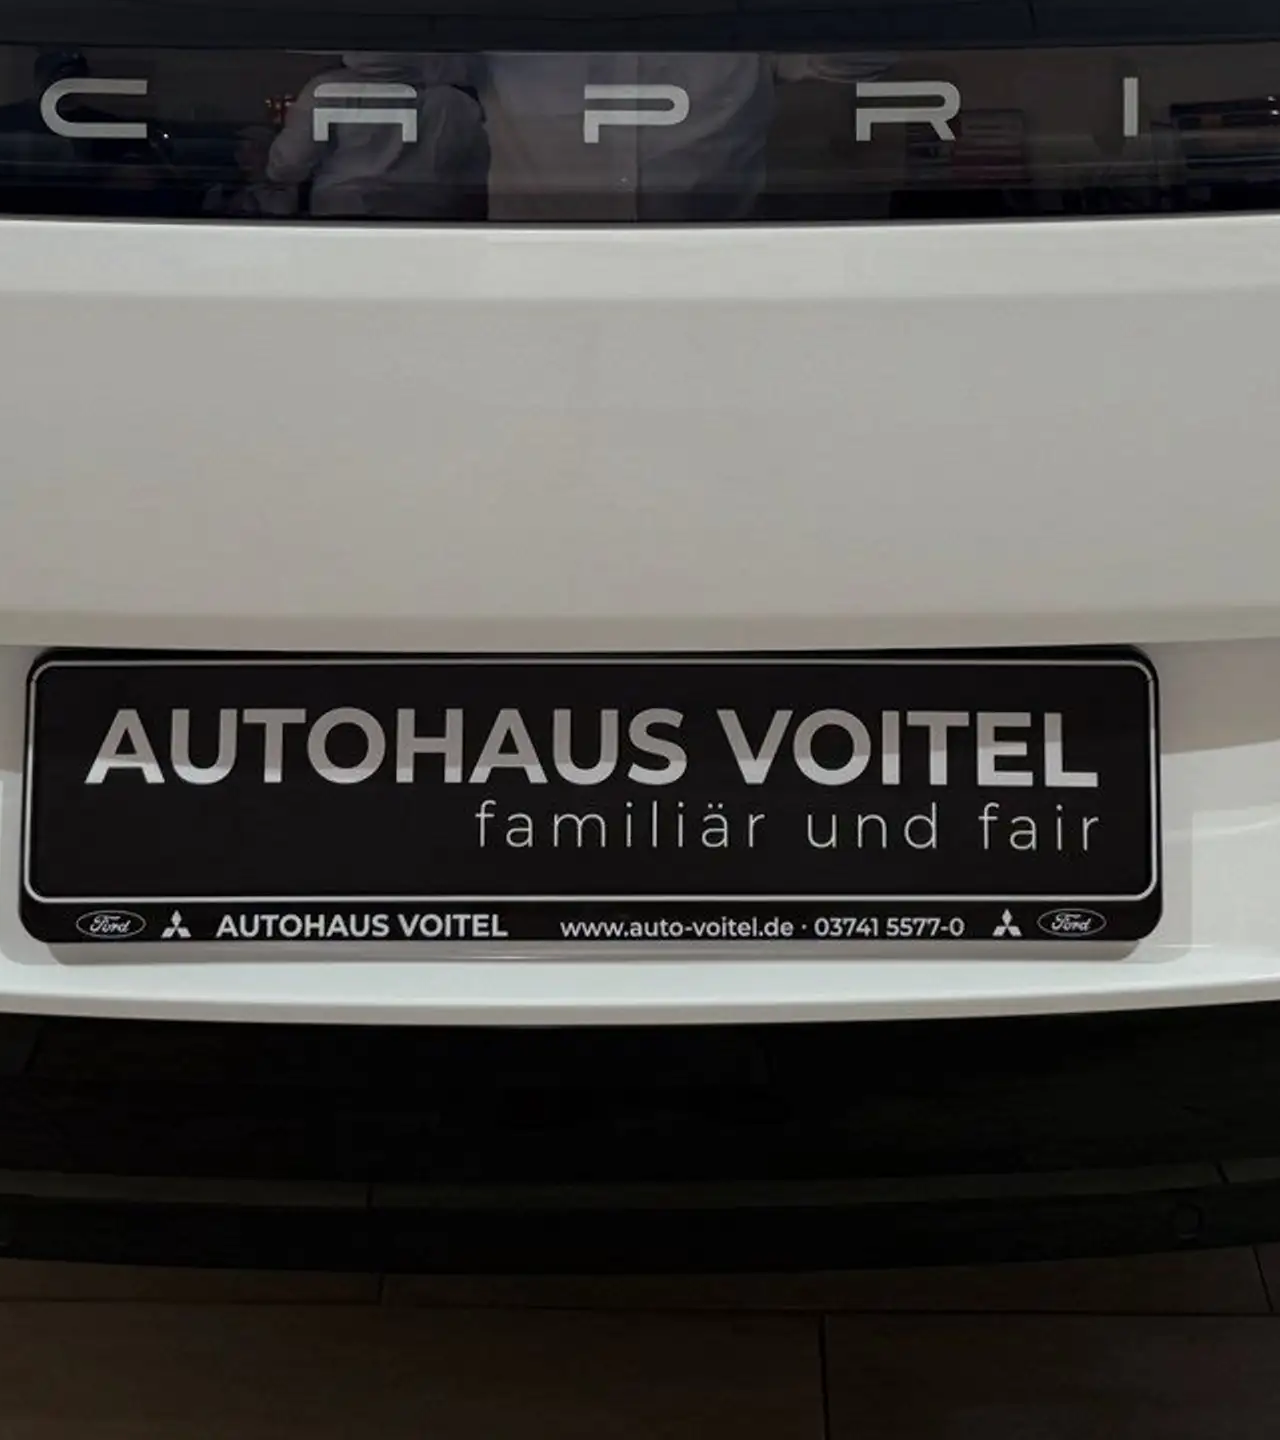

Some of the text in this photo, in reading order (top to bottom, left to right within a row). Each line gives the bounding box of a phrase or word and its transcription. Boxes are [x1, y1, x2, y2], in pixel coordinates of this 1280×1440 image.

[40, 76, 1139, 144] CAPRI
[84, 707, 1099, 788] AUTOHAUS VOITEL
[475, 799, 1100, 852] familiär und fair
[216, 913, 509, 938] AUTOHAUS VOITEL
[559, 916, 966, 938] www.auto-voitel.de 03741 5577-0
